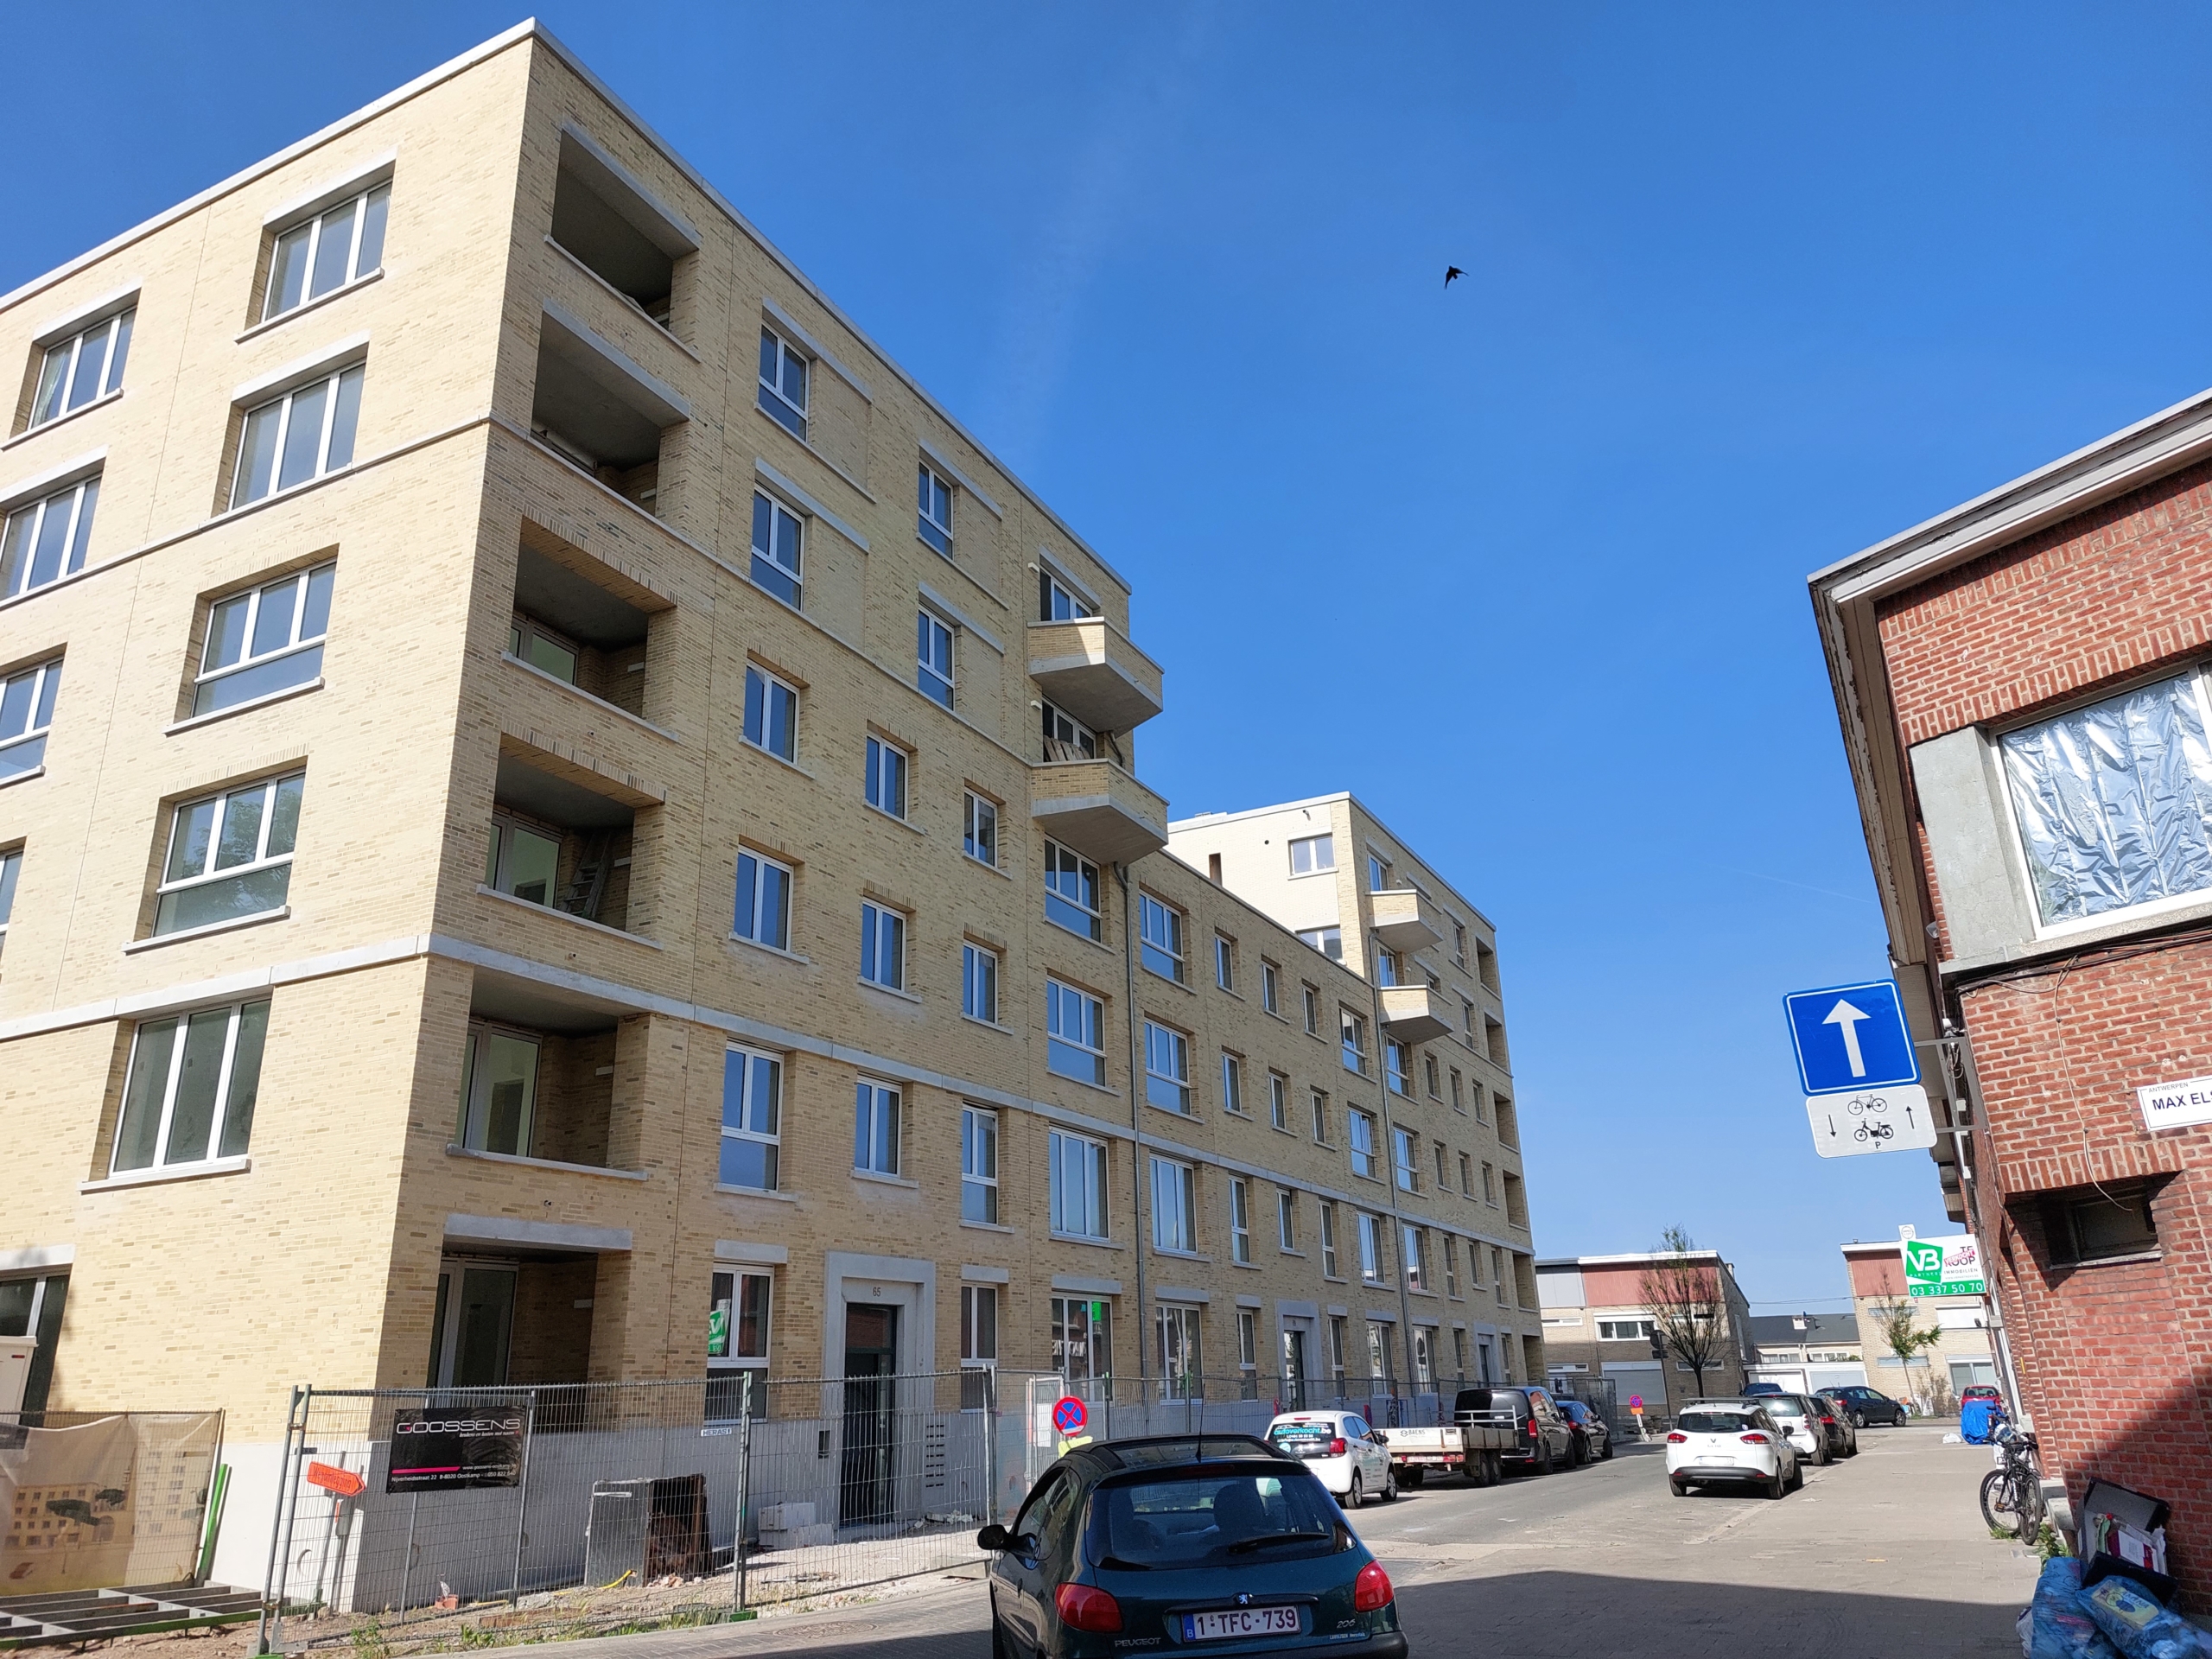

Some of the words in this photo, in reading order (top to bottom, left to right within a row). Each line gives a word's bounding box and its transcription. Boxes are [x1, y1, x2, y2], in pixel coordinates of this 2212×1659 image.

[2149, 1082, 2189, 1093] ANTWERPEN
[2152, 1095, 2187, 1110] MAX
[2190, 1090, 2212, 1105] EL
[1907, 1249, 1941, 1272] VB
[873, 1287, 881, 1296] 65
[1911, 1287, 1925, 1296] 03
[1928, 1285, 1947, 1294] 337
[1951, 1283, 1965, 1293] 50
[1969, 1282, 1983, 1292] 70
[397, 1418, 521, 1434] GOOSSENS
[1337, 1618, 1356, 1628] 206
[1186, 1629, 1194, 1638] B
[1115, 1637, 1160, 1647] PEUGEOT
